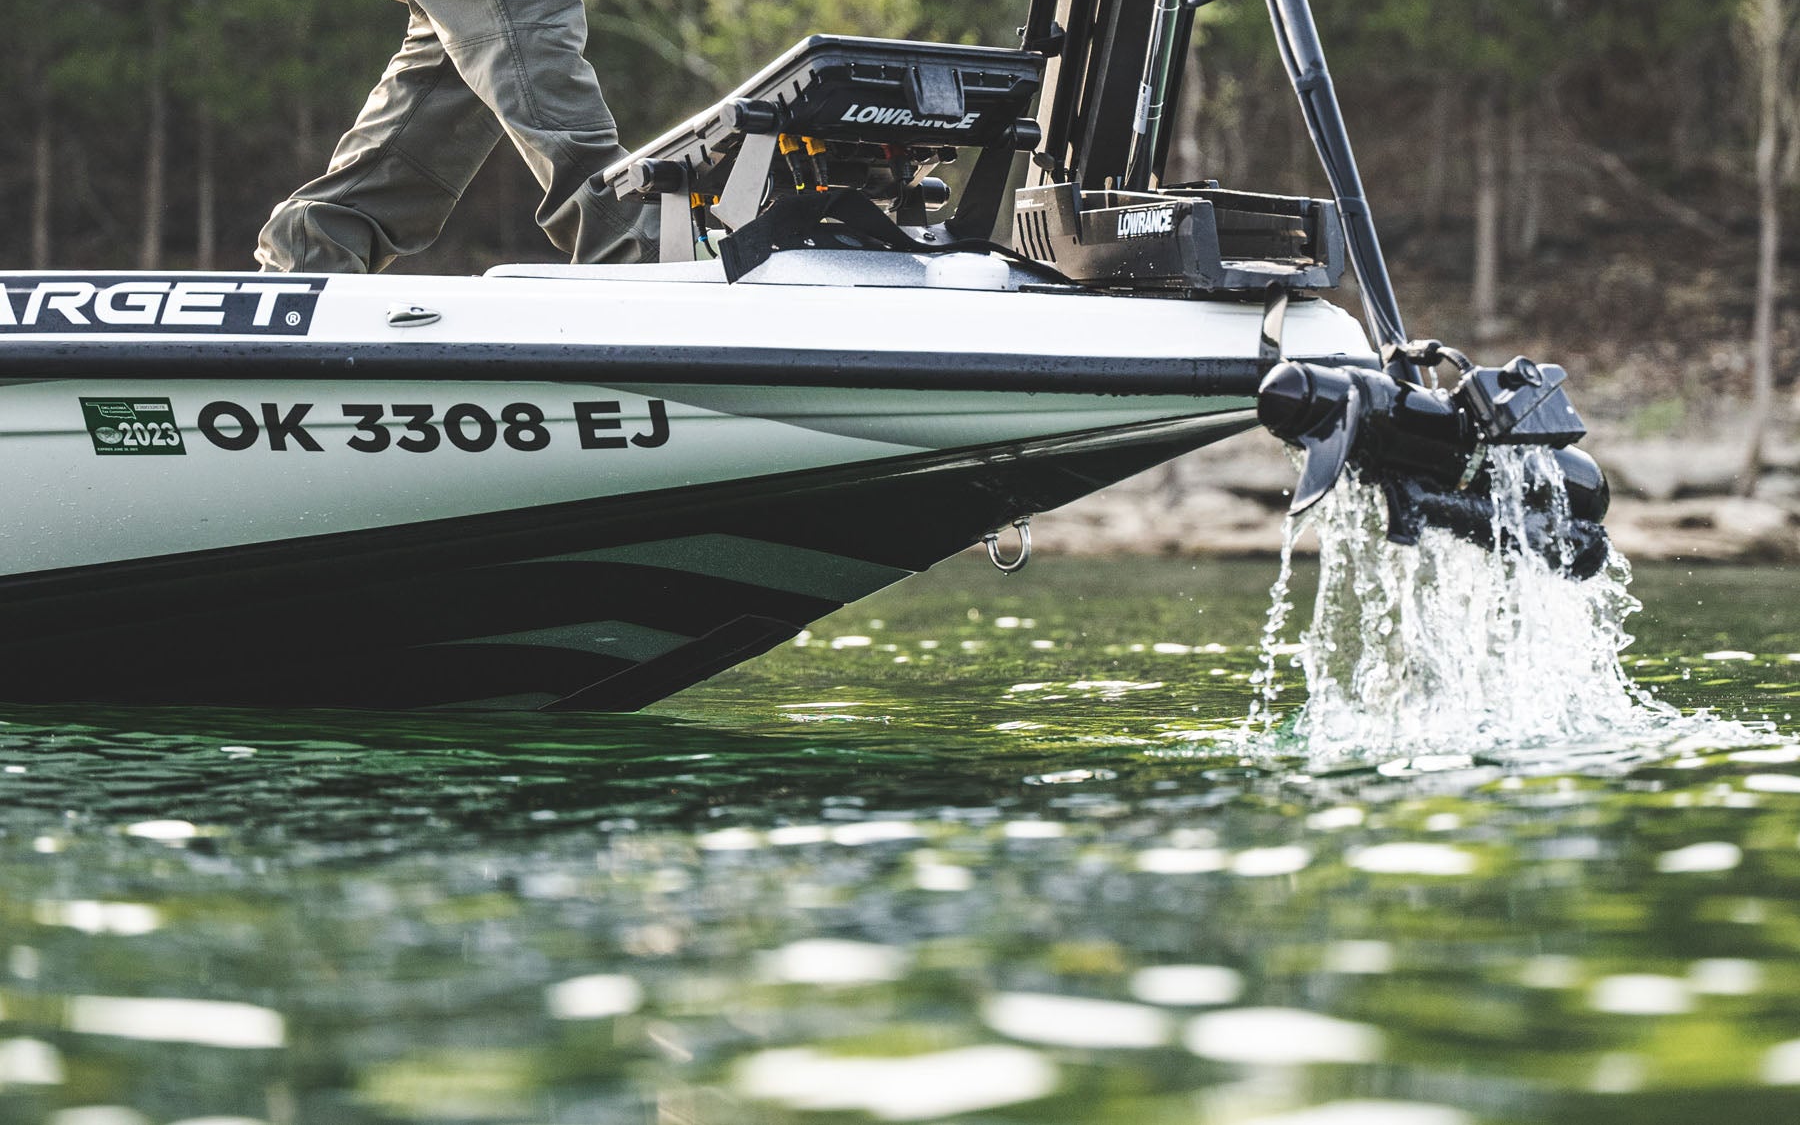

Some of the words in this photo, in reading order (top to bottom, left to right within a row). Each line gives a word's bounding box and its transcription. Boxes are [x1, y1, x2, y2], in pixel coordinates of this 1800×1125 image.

[1117, 208, 1173, 236] LOWRANCE
[118, 422, 180, 446] 2023
[197, 401, 325, 452] OK
[341, 402, 551, 453] 3308
[573, 400, 670, 450] EJ
